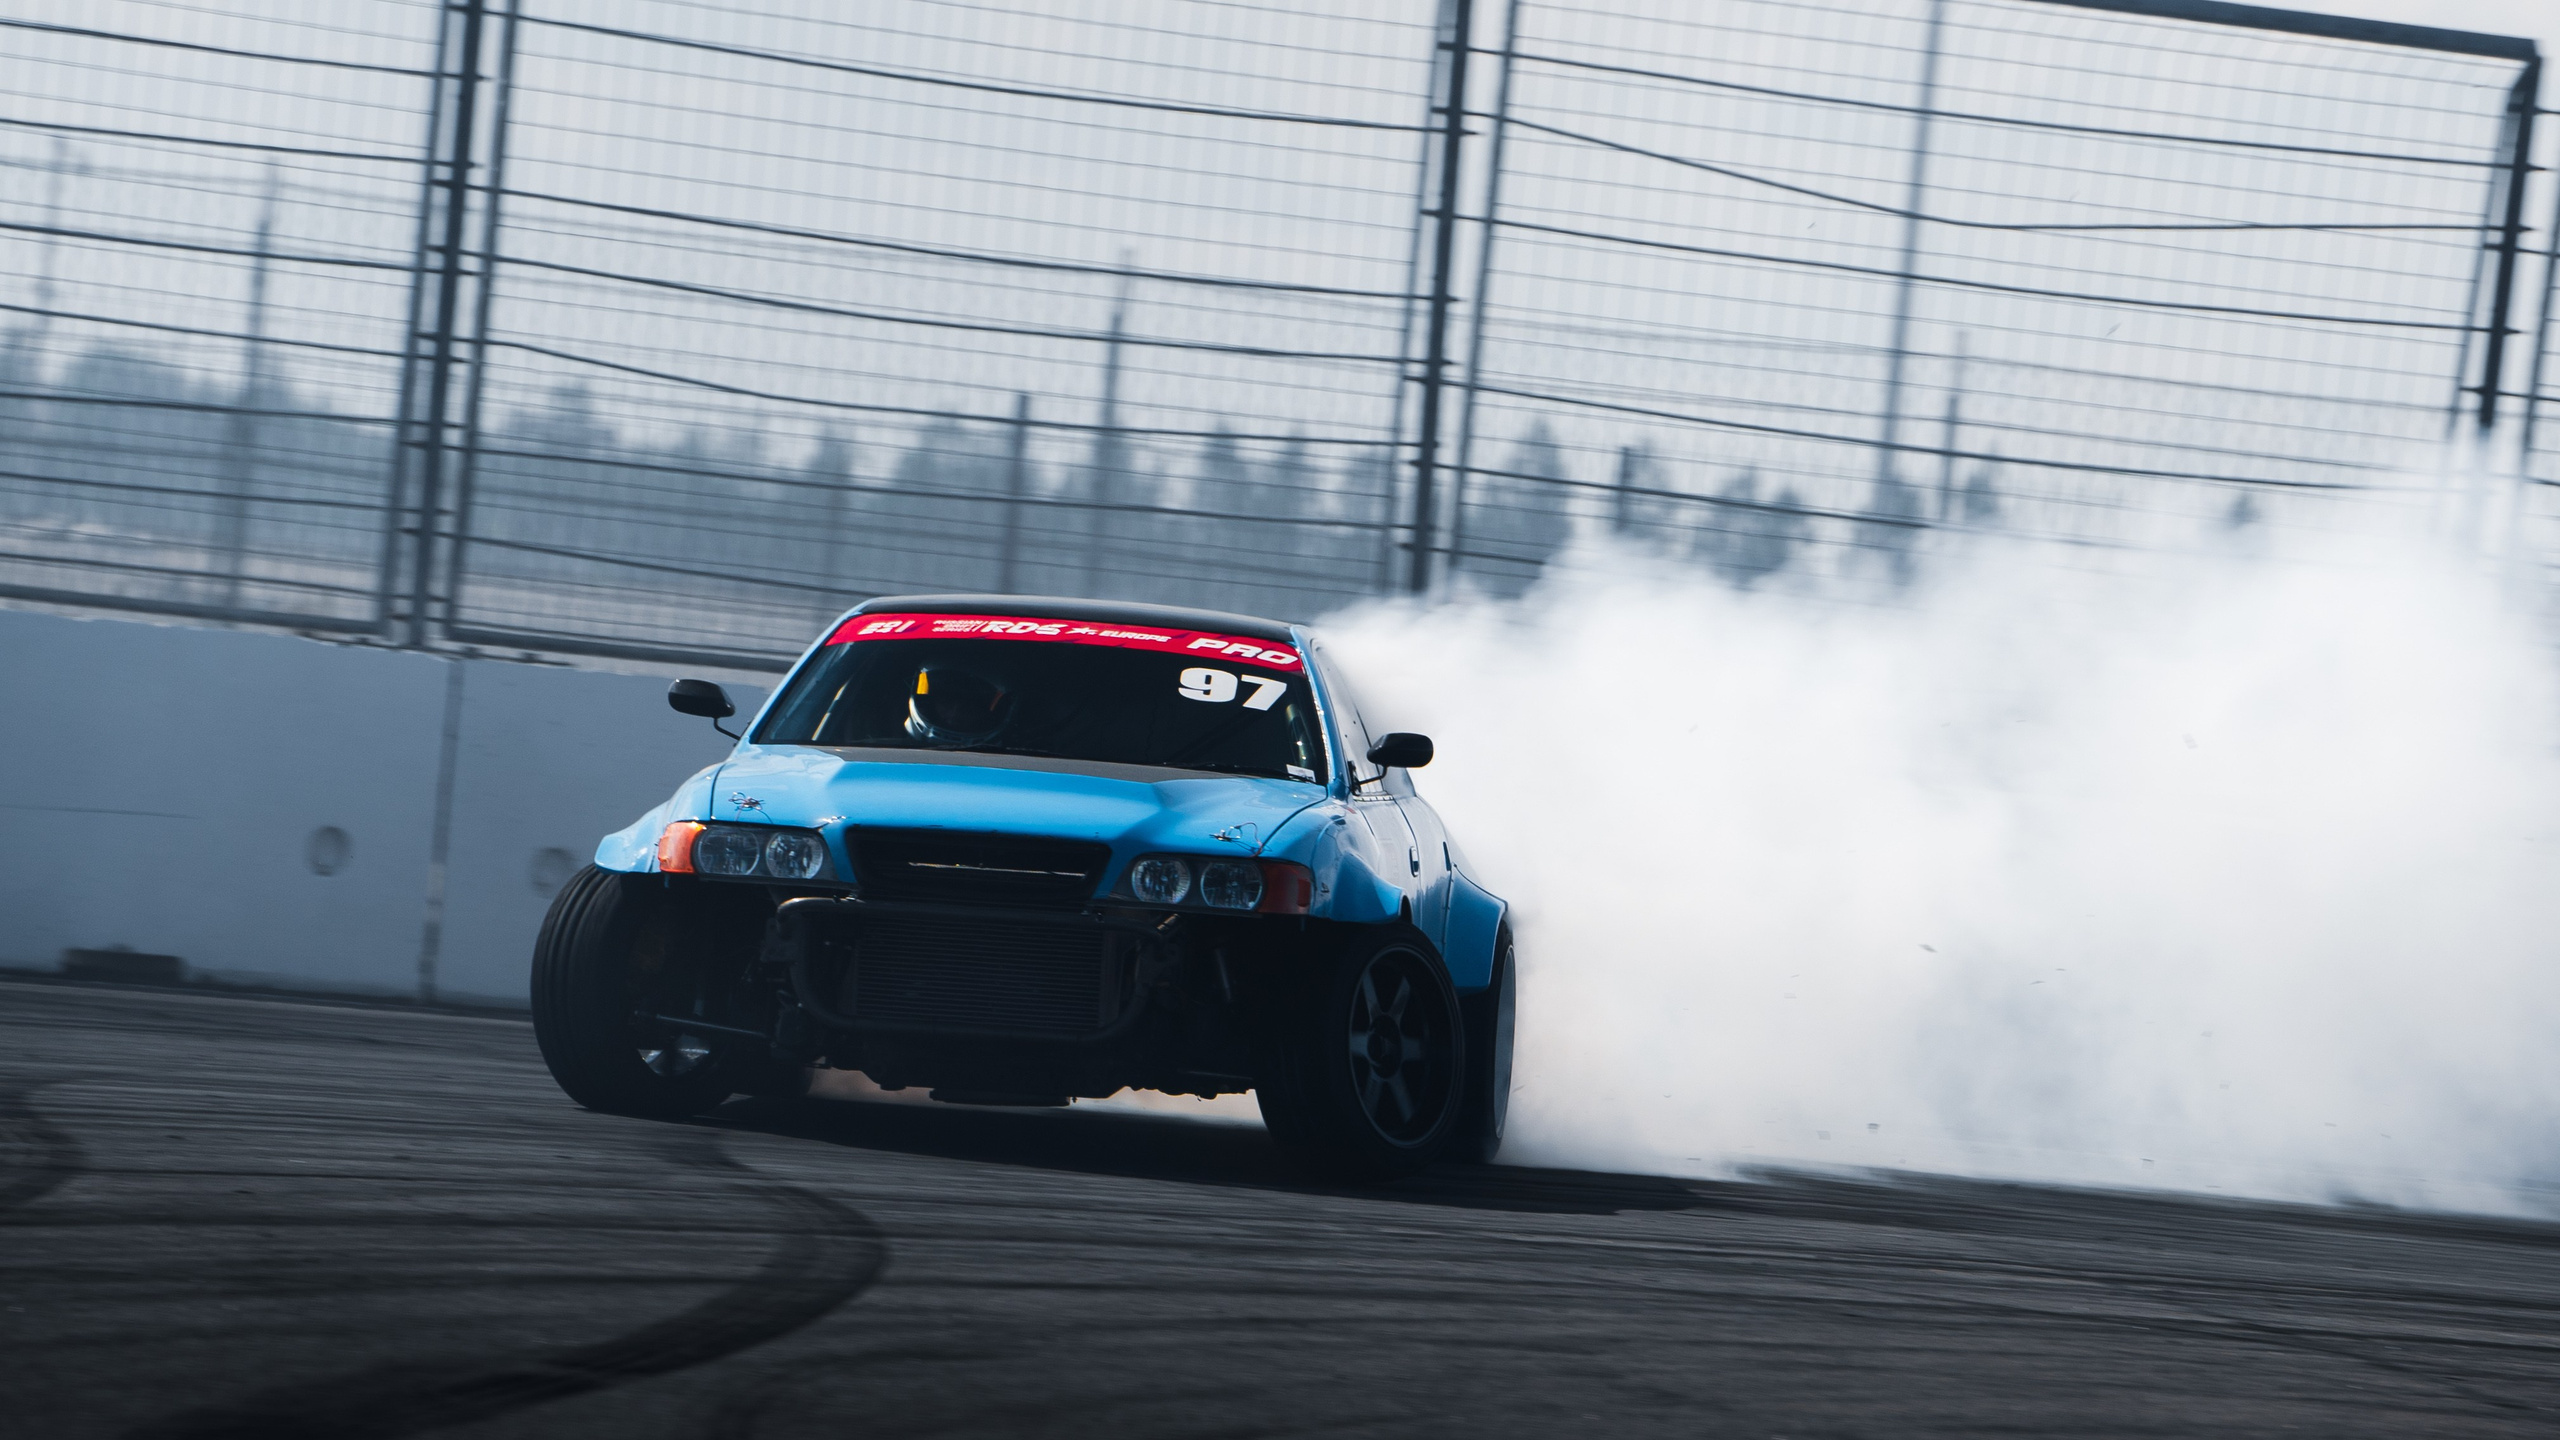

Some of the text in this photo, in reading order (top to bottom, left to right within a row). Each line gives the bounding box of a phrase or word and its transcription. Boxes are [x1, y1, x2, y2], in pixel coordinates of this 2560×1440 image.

[980, 621, 1068, 635] RDS
[1098, 630, 1172, 642] EUROPE
[1186, 638, 1298, 664] PRO
[1178, 667, 1288, 711] 97
